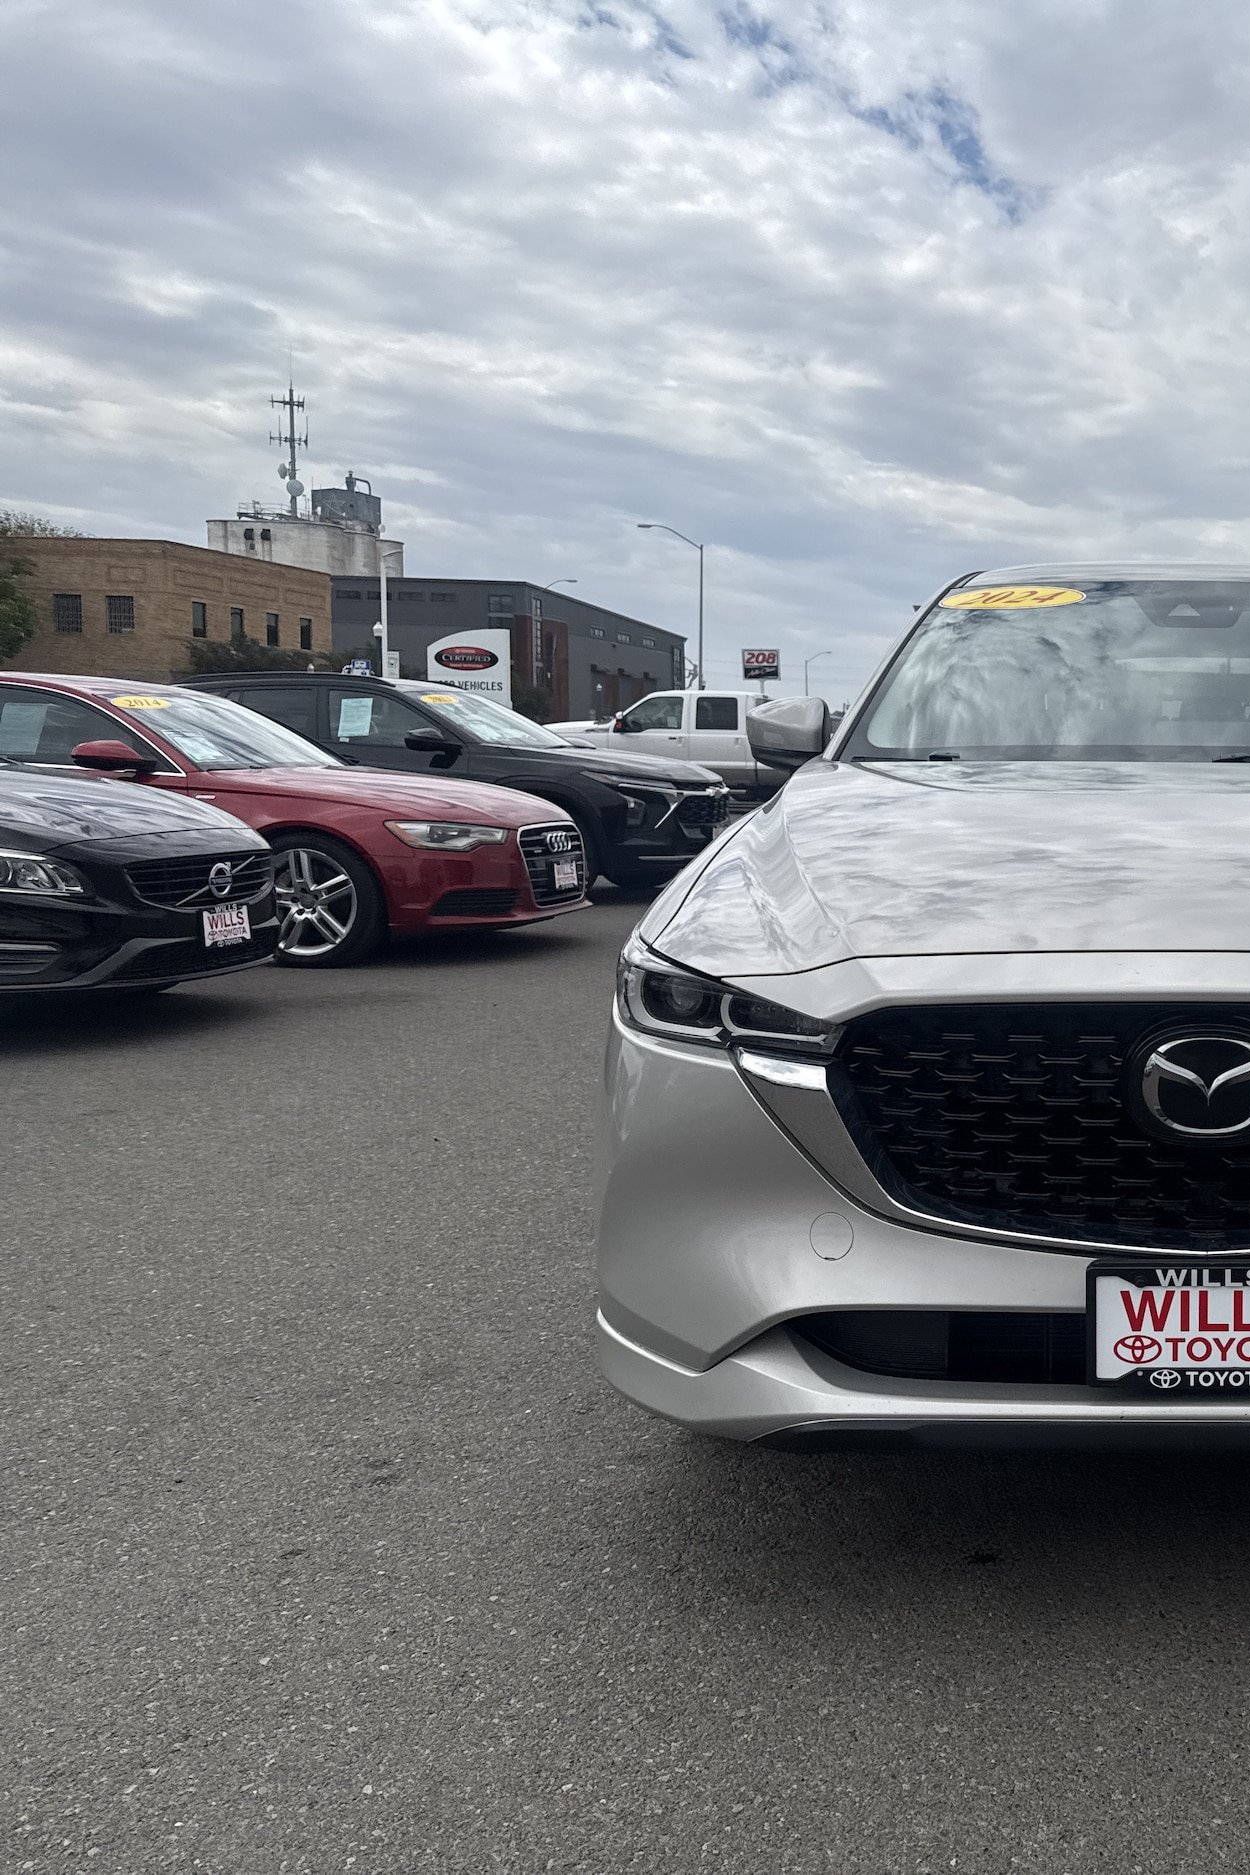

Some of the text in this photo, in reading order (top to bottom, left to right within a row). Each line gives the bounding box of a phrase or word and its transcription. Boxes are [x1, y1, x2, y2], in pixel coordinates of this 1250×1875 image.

[957, 590, 1067, 606] 2024
[441, 653, 492, 662] CERTIFIED
[745, 652, 777, 664] 208
[458, 680, 503, 692] VEHICLES
[124, 699, 161, 707] 2014
[215, 903, 238, 913] WILLS
[208, 911, 244, 930] WILLS
[218, 926, 247, 937] TOYOTA
